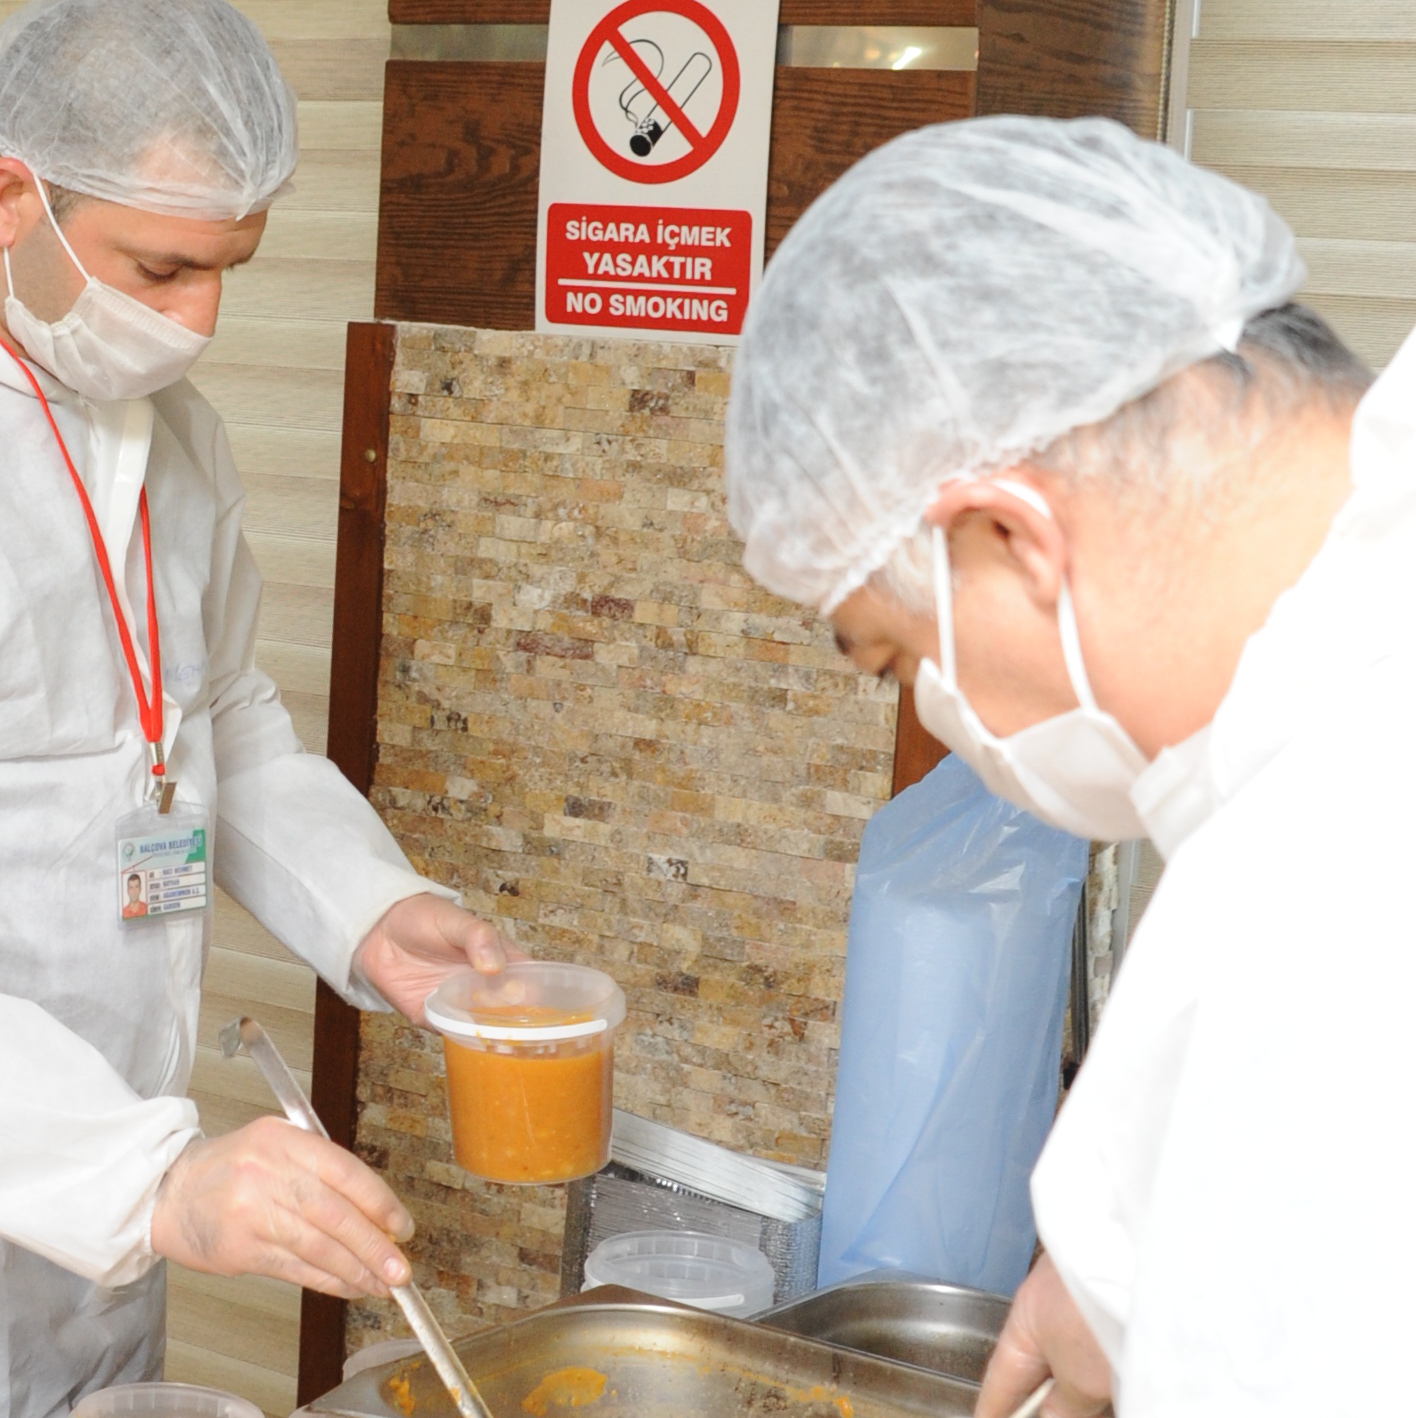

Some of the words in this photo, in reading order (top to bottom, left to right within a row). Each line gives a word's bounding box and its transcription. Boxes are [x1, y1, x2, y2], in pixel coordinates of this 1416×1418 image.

[565, 216, 650, 243] SİGARA
[657, 219, 732, 250] İÇMEK
[583, 252, 712, 280] YASAKTIR
[566, 292, 603, 315] NO
[609, 294, 728, 322] SMOKING
